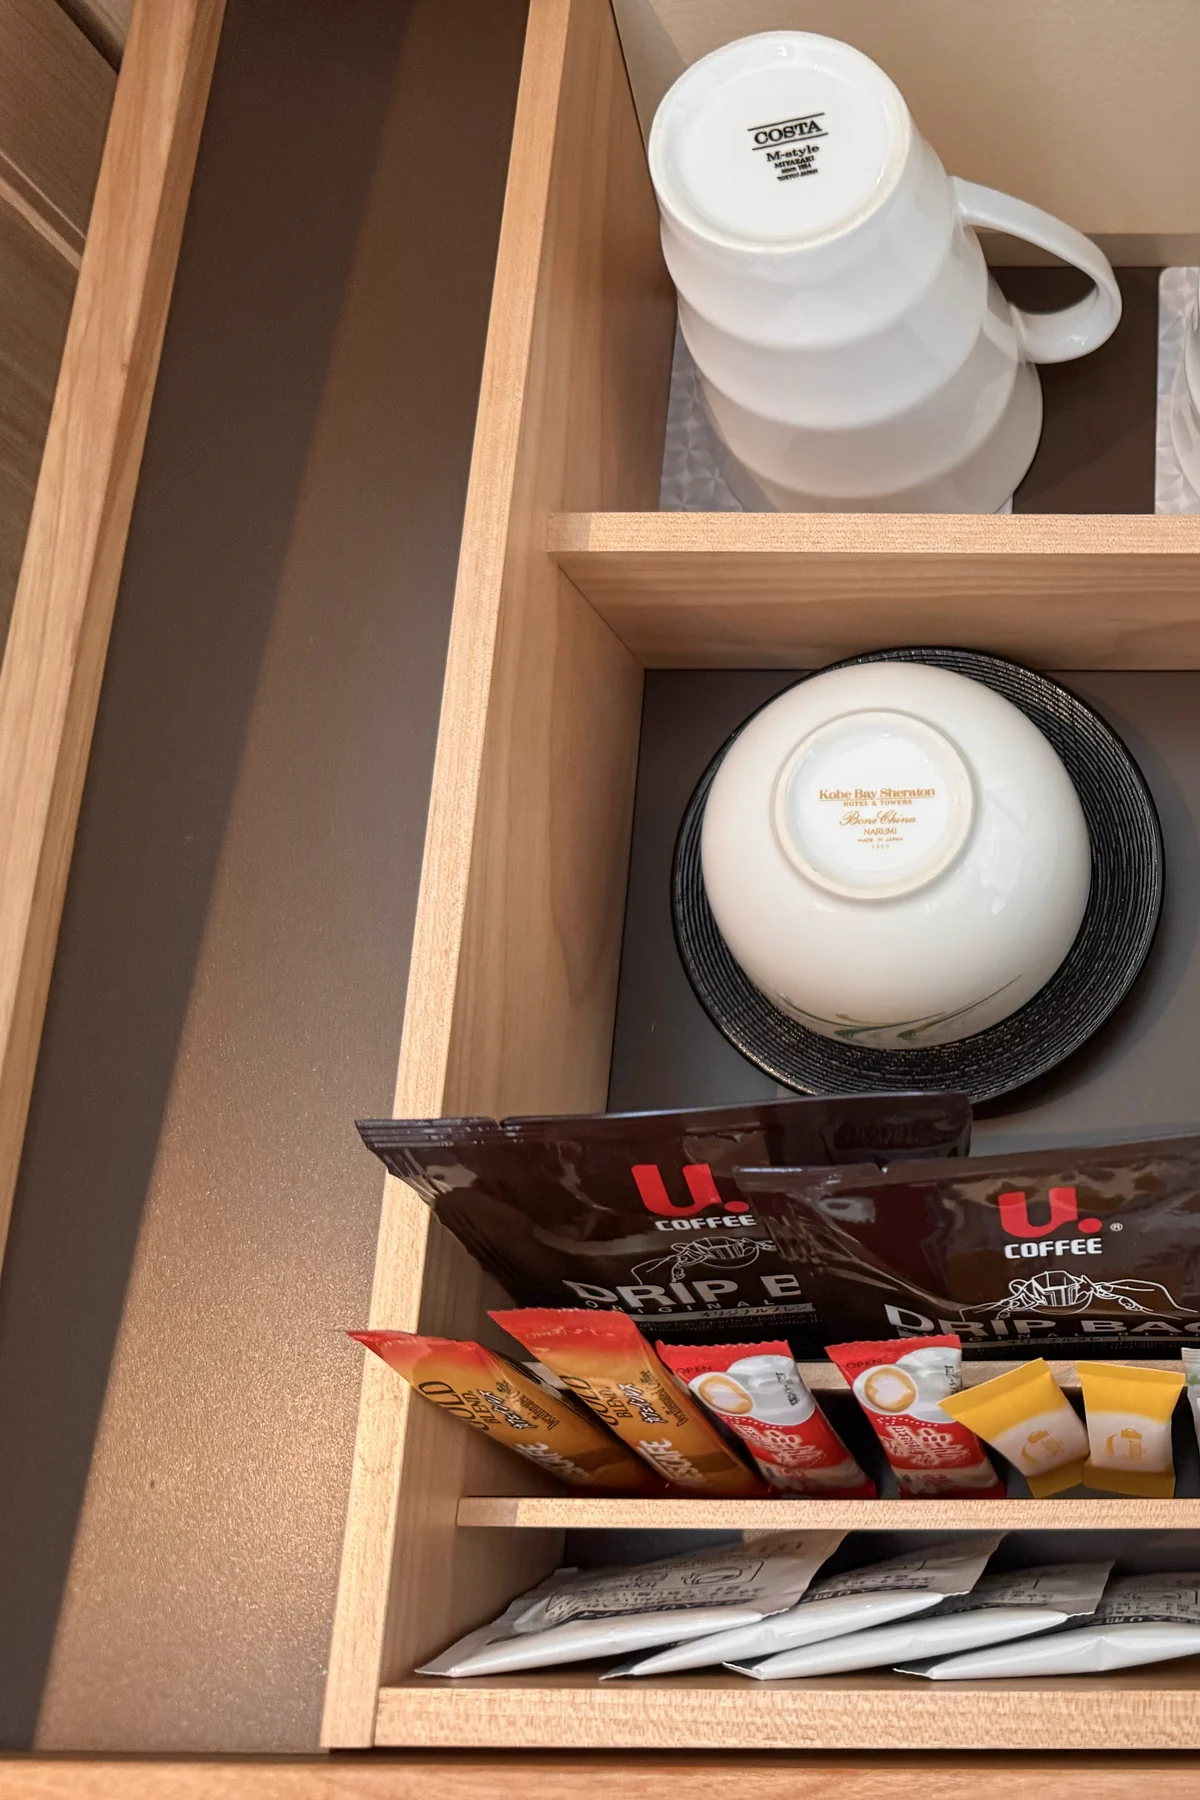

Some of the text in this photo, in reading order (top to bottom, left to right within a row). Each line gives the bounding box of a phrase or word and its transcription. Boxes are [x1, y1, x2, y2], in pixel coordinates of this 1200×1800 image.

[754, 120, 823, 145] COSTA
[766, 144, 820, 162] M-style
[774, 155, 815, 168] MIYAZAKI
[820, 787, 935, 800] Kobe Bay Sheraton
[839, 809, 916, 826] Bone China
[863, 827, 897, 836] NARUMI
[655, 1214, 757, 1231] COFFEE
[1004, 1238, 1103, 1259] COFFEE
[562, 1279, 739, 1308] DRIP
[701, 1304, 809, 1318] オリジナルブレン
[884, 1303, 1057, 1337] DRIP
[676, 1365, 713, 1375] OPEN
[845, 1357, 883, 1370] OPEN
[461, 1389, 502, 1425] BLEND
[599, 1386, 634, 1419] BLEND
